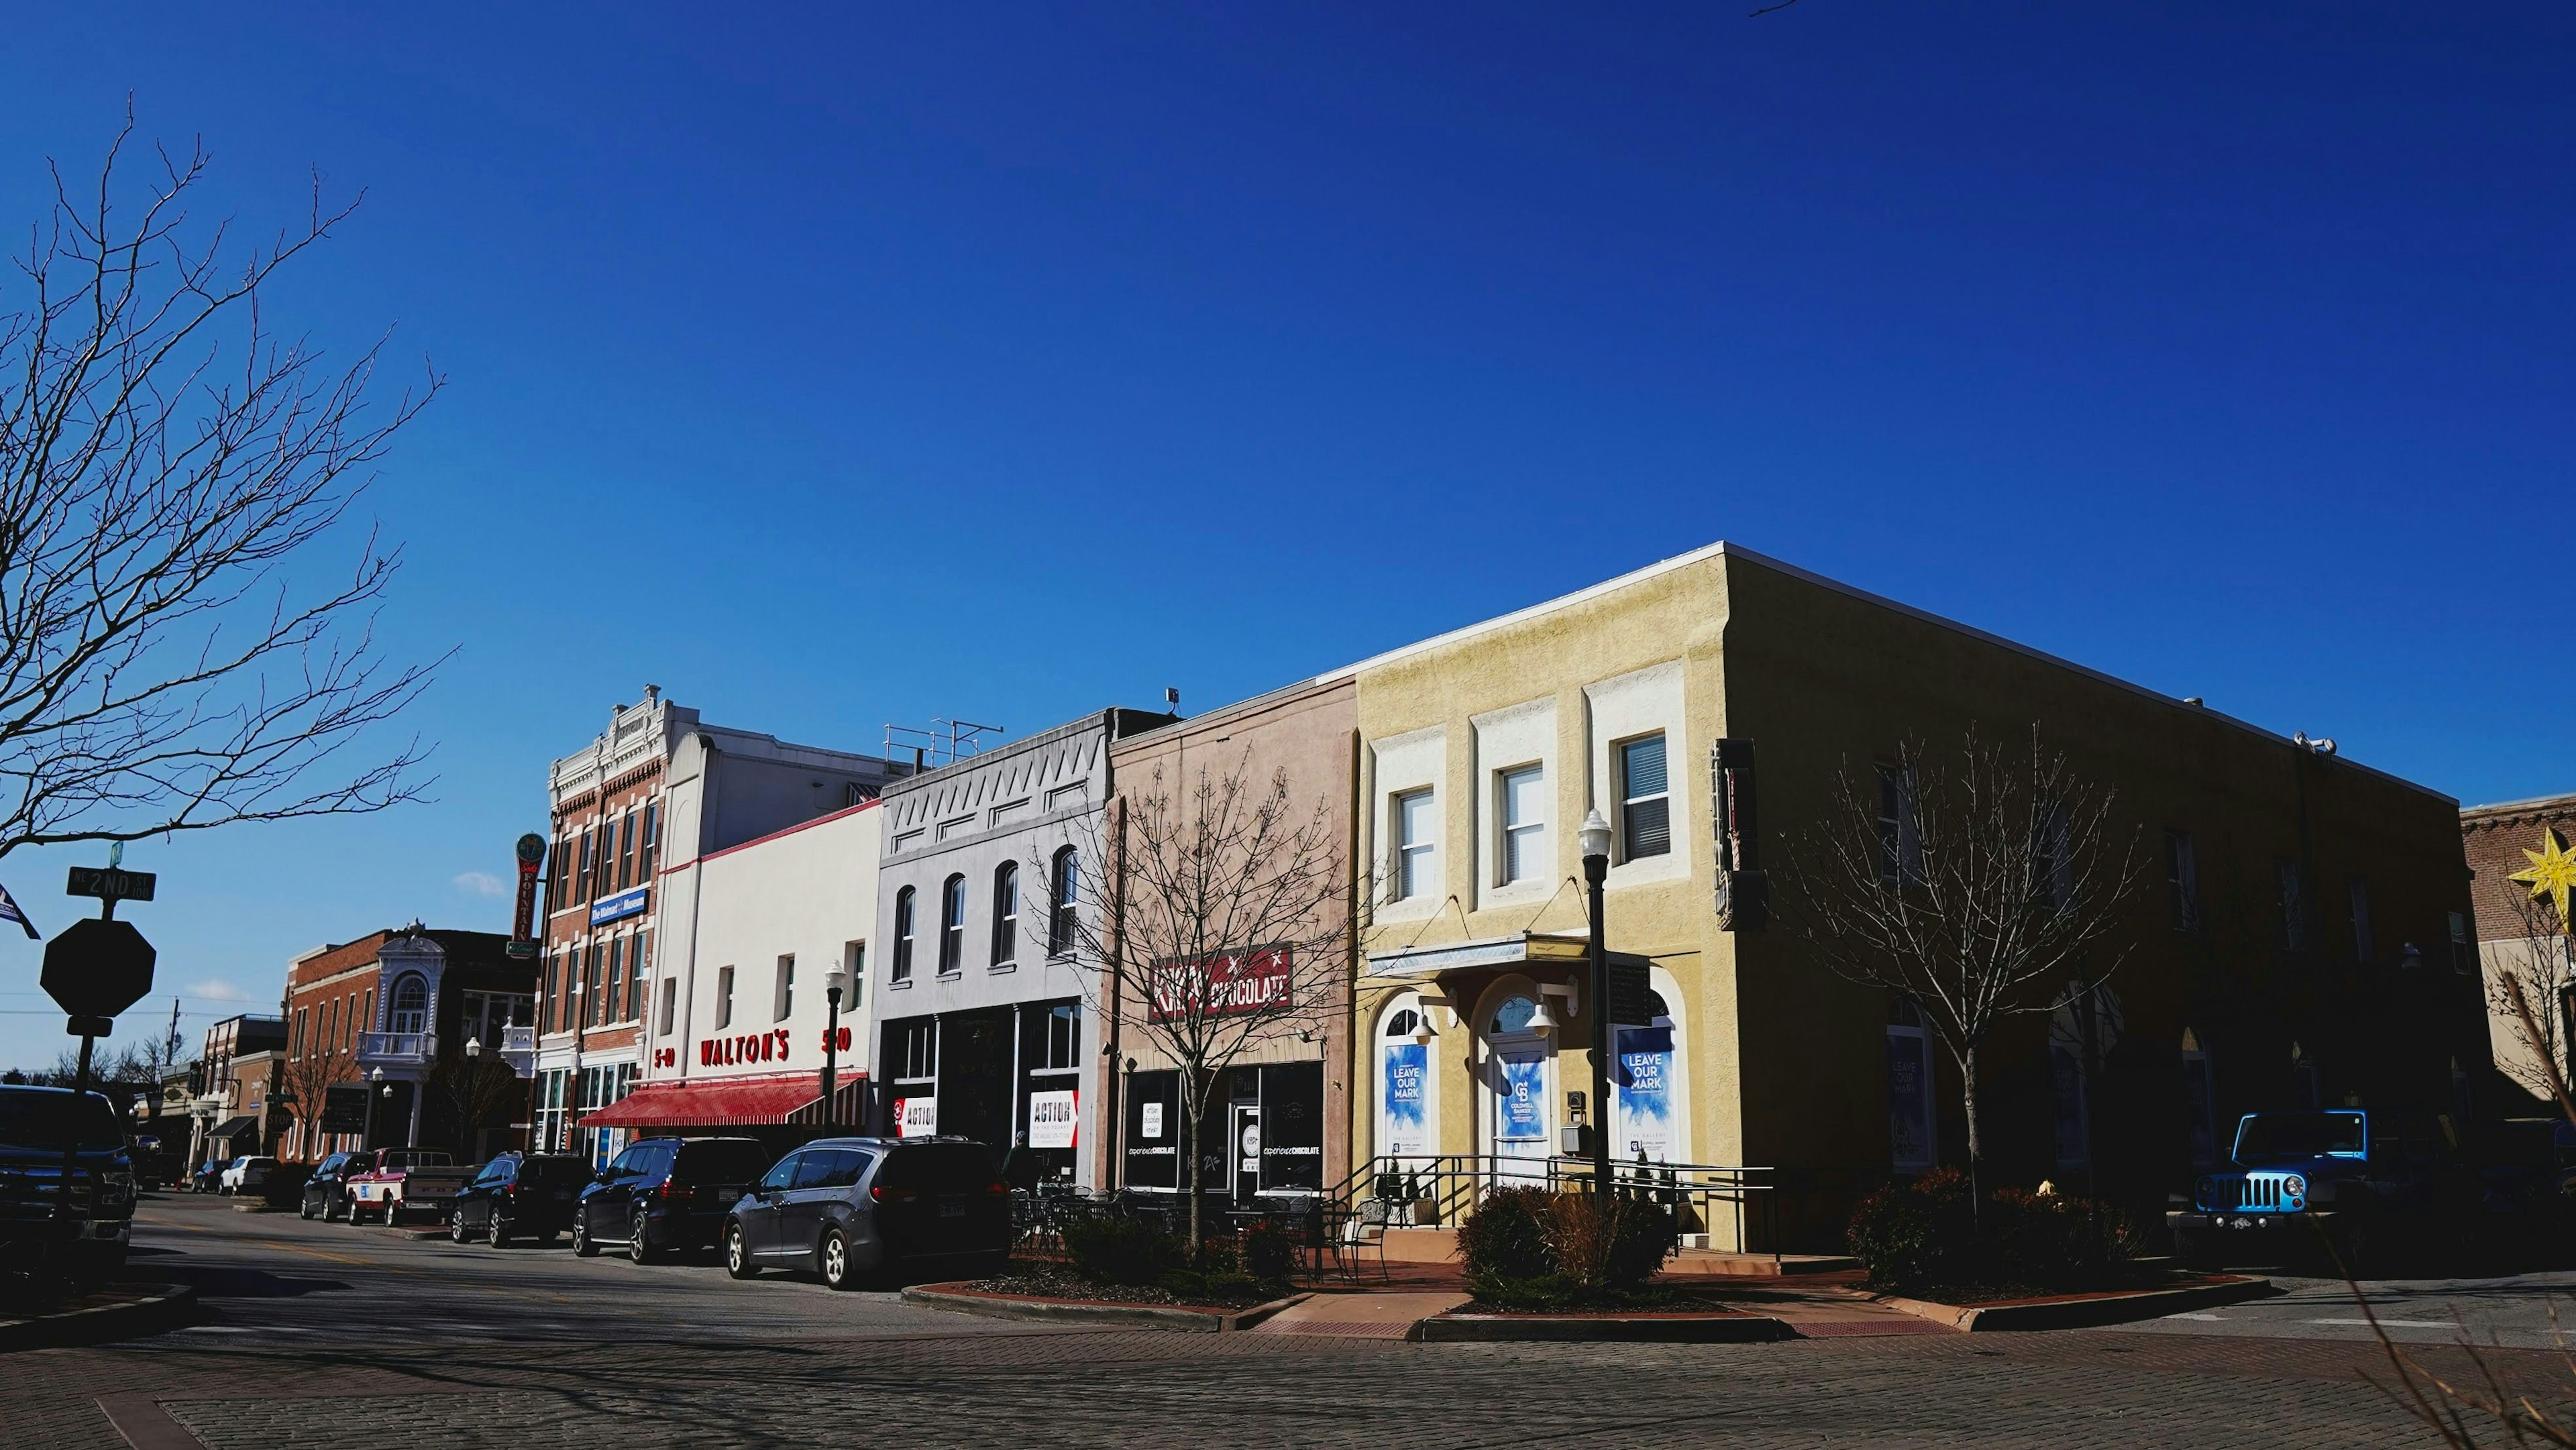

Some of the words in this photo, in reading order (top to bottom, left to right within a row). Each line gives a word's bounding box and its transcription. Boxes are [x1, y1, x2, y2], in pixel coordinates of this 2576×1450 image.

[74, 872, 87, 883] NE
[90, 873, 129, 895] 2ND
[136, 876, 148, 887] ST
[518, 873, 533, 942] FOUNTAIN
[592, 909, 600, 921] The
[600, 903, 618, 918] Walmart
[623, 896, 644, 911] Museum
[1211, 974, 1287, 1009] CHOCOLATE
[701, 1028, 789, 1068] WALTON'S
[1629, 1054, 1662, 1066] LEAVE
[1393, 1068, 1419, 1078] LEAVE
[1633, 1066, 1658, 1077] OUR
[1397, 1078, 1415, 1089] OUR
[1631, 1078, 1662, 1089] MARK
[1395, 1088, 1419, 1098] MARK
[1034, 1101, 1070, 1123] ACTION
[268, 1114, 292, 1125] STOP
